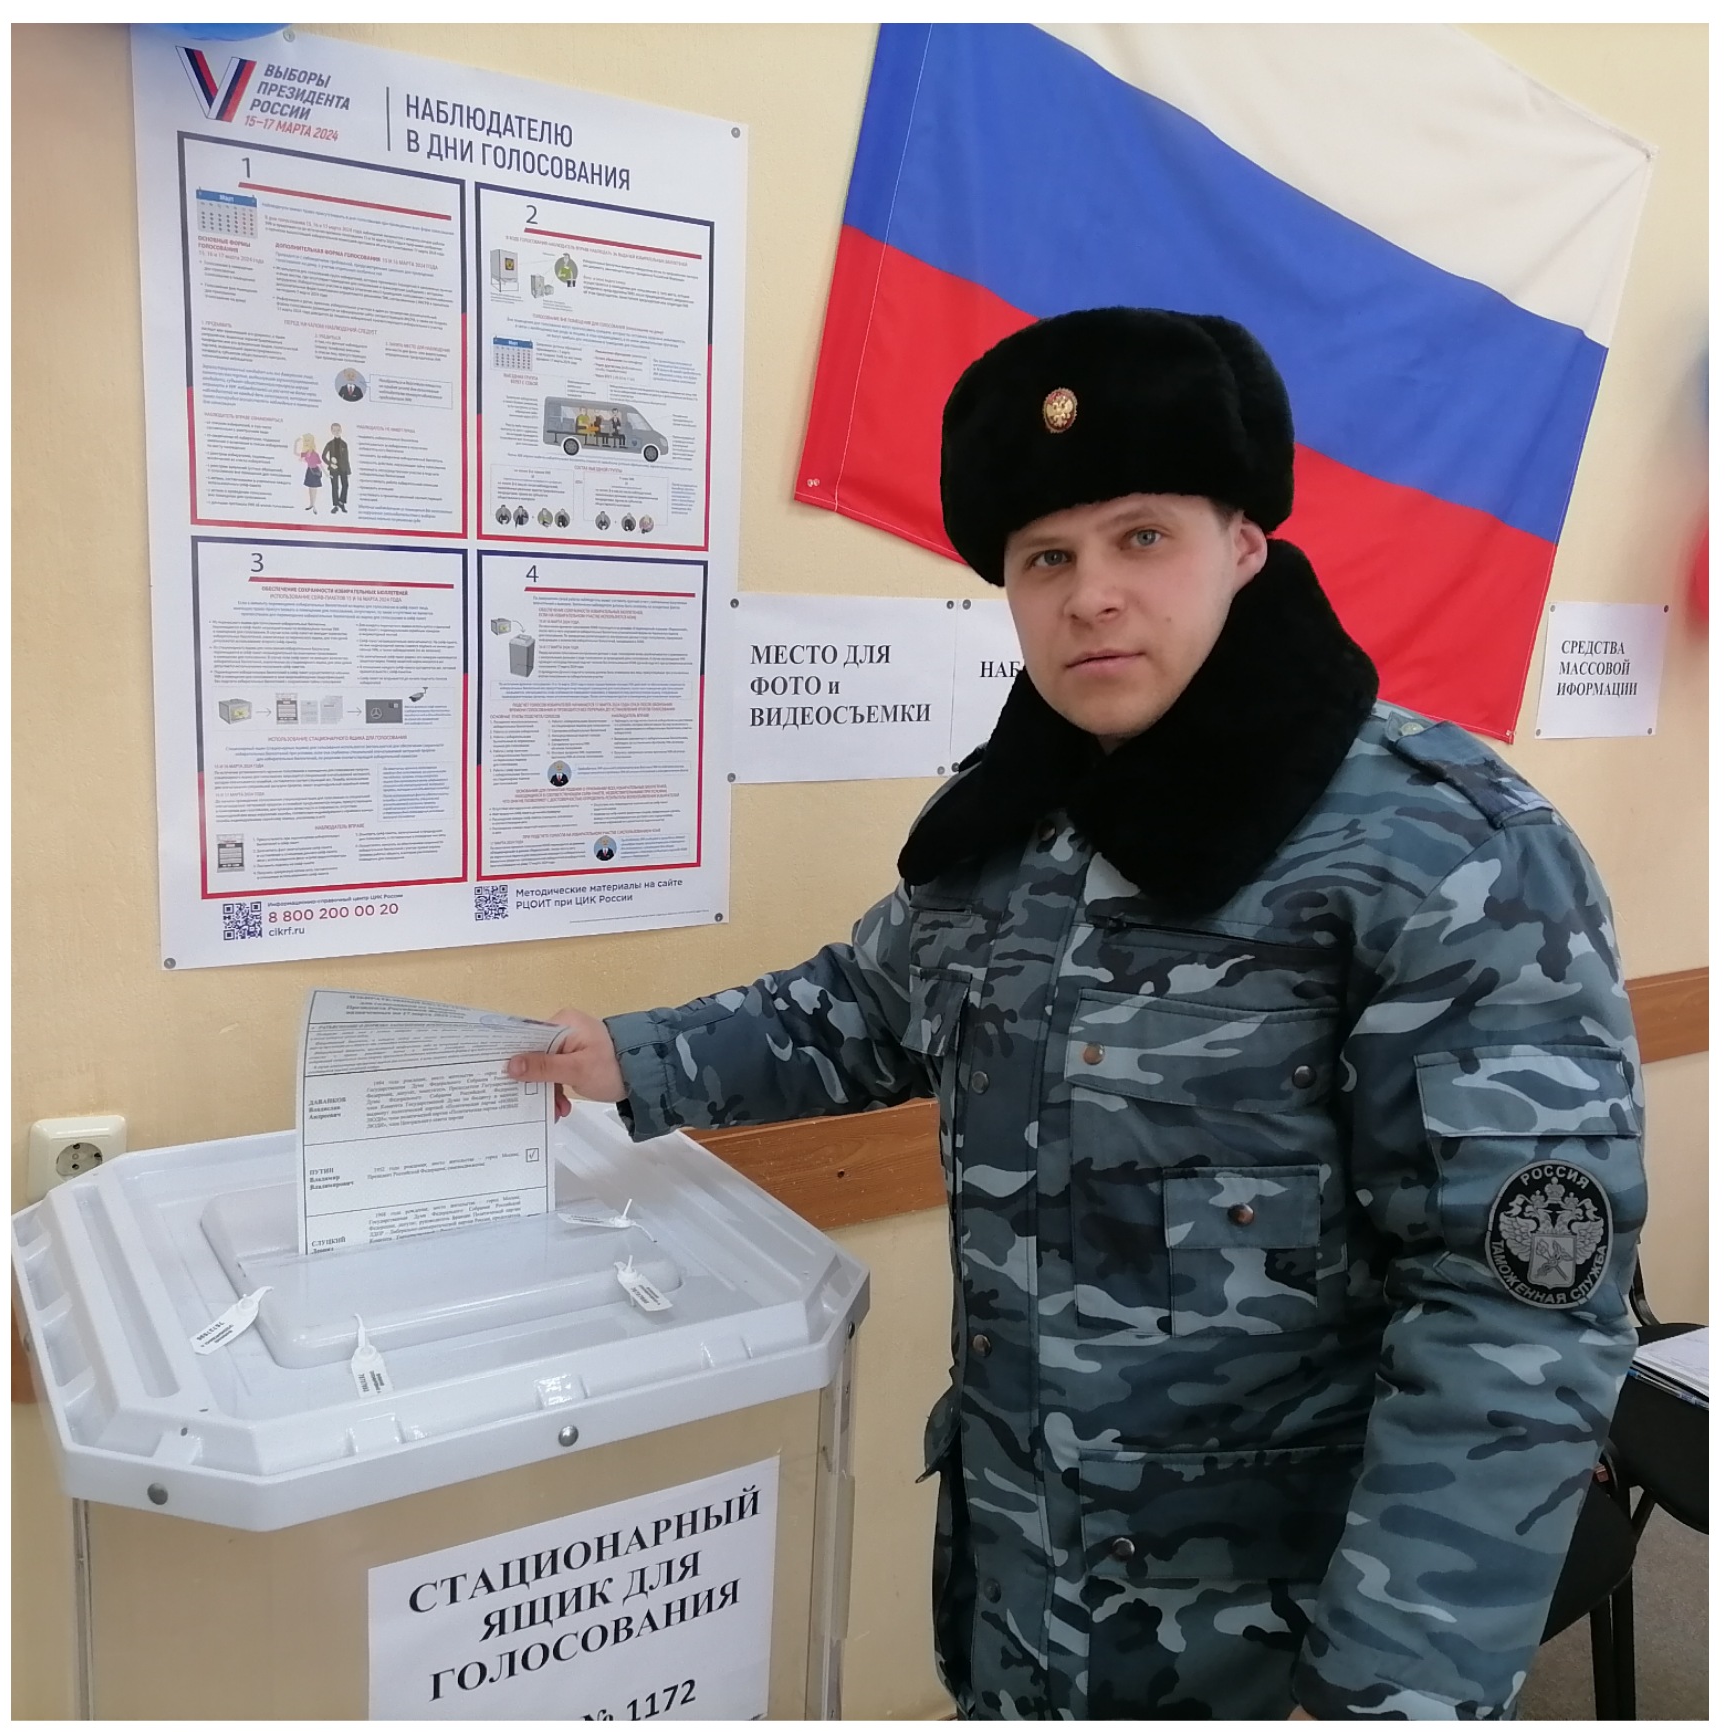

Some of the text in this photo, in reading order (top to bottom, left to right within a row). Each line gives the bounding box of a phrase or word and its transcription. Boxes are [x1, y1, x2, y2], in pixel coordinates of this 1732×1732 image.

[264, 64, 331, 88] ВЫБОРЫ
[256, 81, 350, 111] ПРЕЗИДЕНТА
[250, 99, 311, 121] РОССИИ
[276, 121, 312, 138] МАРТА
[313, 126, 339, 142] 2024
[406, 94, 573, 148] НАБЛЮДАТЕЛЮ
[242, 157, 251, 179] 1
[407, 130, 630, 191] В ДНИ ГОЛОСОВАНИЯ
[525, 204, 538, 225] 2
[250, 552, 264, 572] 3
[526, 565, 539, 582] 4
[750, 644, 891, 668] МЕСТО ДЛЯ
[1561, 640, 1625, 656] СРЕДСТВА
[1559, 659, 1630, 675] МАССОВОЙ
[750, 676, 840, 695] ФОТО и
[1556, 682, 1638, 697] ИФОРМАЦИИ
[750, 704, 931, 730] ВИДЕОСЪЕМКИ
[516, 886, 586, 898] Методические
[590, 882, 641, 894] материалы
[657, 878, 683, 887] сайте
[516, 893, 633, 910] РЦОИТ при ЦИК России
[268, 903, 398, 923] 8 800 200 00 20
[268, 926, 305, 937] cikrf.ru
[309, 1167, 334, 1175] ПУТИН
[310, 1175, 340, 1183] Владимир
[1520, 1165, 1589, 1189] РОССИЯ
[310, 1181, 354, 1190] Владимирович
[311, 1236, 346, 1247] СЛУЦКИЙ
[1492, 1240, 1606, 1304] ТАМОЖЕННАЯ СЛУЖБА
[408, 1484, 761, 1614] СТАЦИОНАРНЫЙ
[479, 1550, 702, 1643] ЯЩИК ДЛЯ
[429, 1578, 740, 1702] ГОЛОСОВАНИЯ
[626, 1678, 696, 1720] 1172
